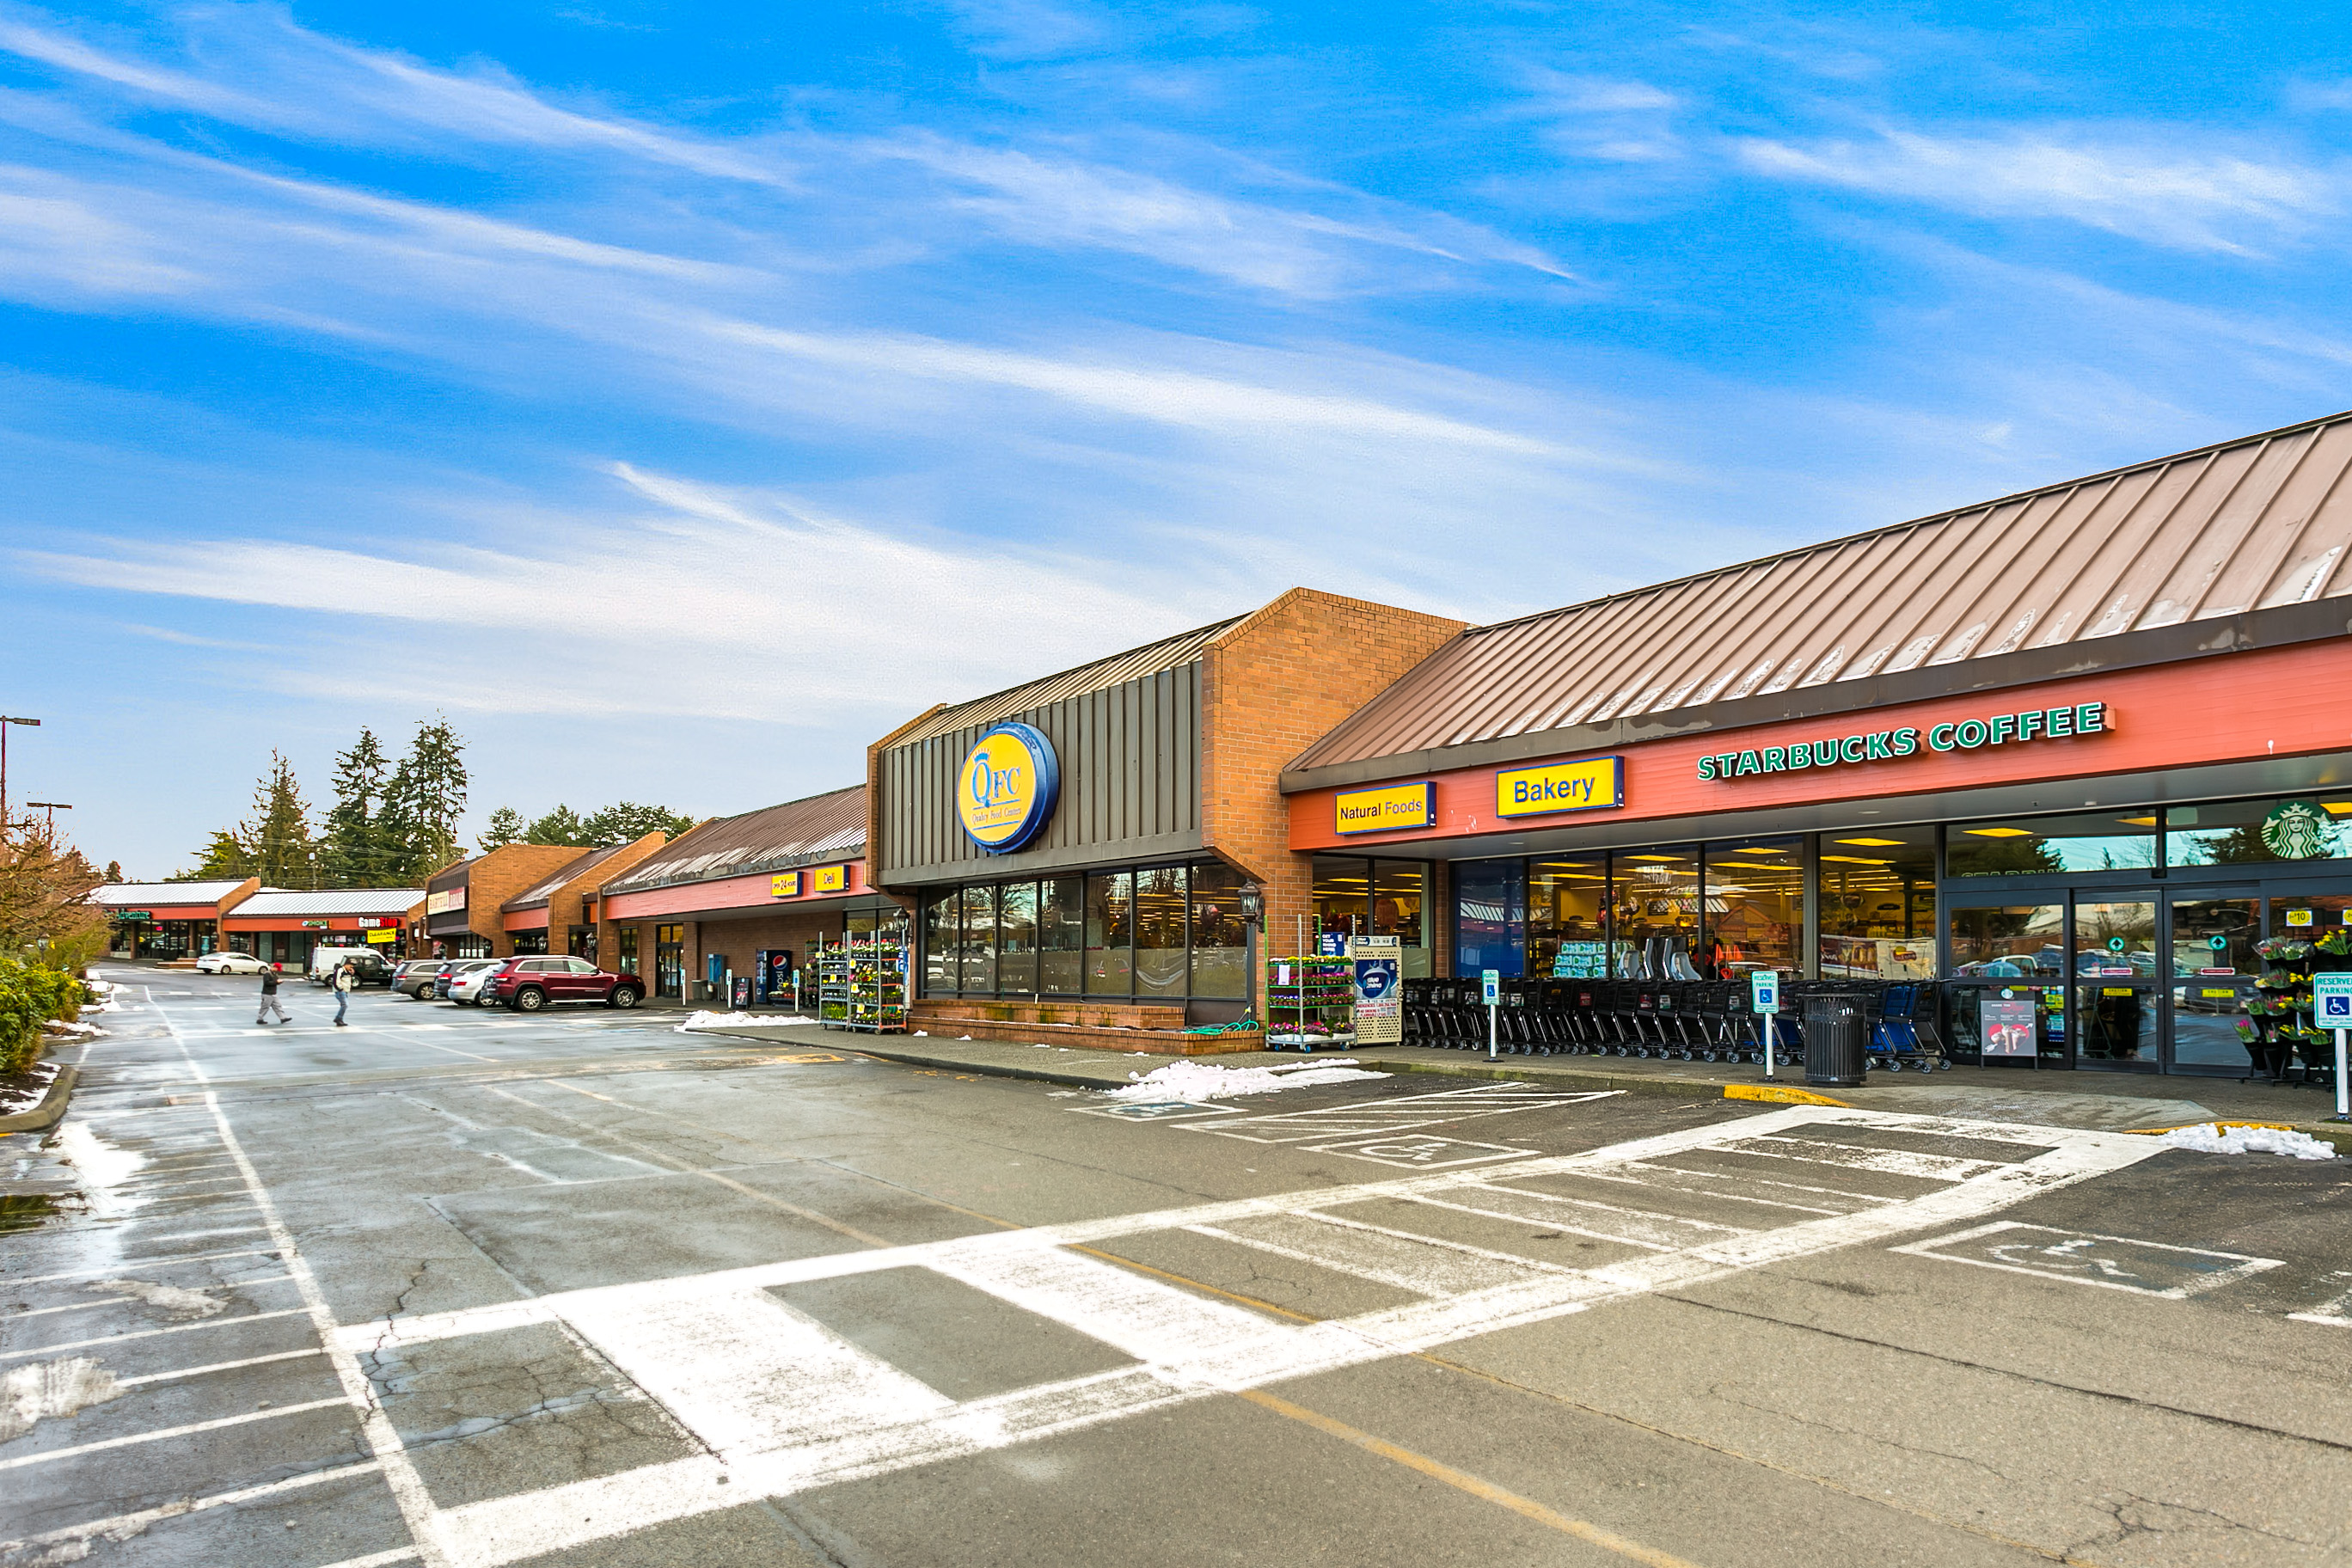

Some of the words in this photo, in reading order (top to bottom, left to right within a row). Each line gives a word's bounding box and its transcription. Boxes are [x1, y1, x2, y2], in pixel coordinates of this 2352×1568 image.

[1697, 727, 1916, 781] STARBUCKS
[1928, 701, 2103, 752] COFFEE
[971, 762, 1021, 808] QFC
[1515, 776, 1595, 803] Bakery
[990, 808, 1001, 819] Food
[1340, 803, 1381, 820] Natural
[1385, 799, 1423, 815] Foods
[823, 873, 835, 885] Deli
[358, 916, 397, 928] GameStop
